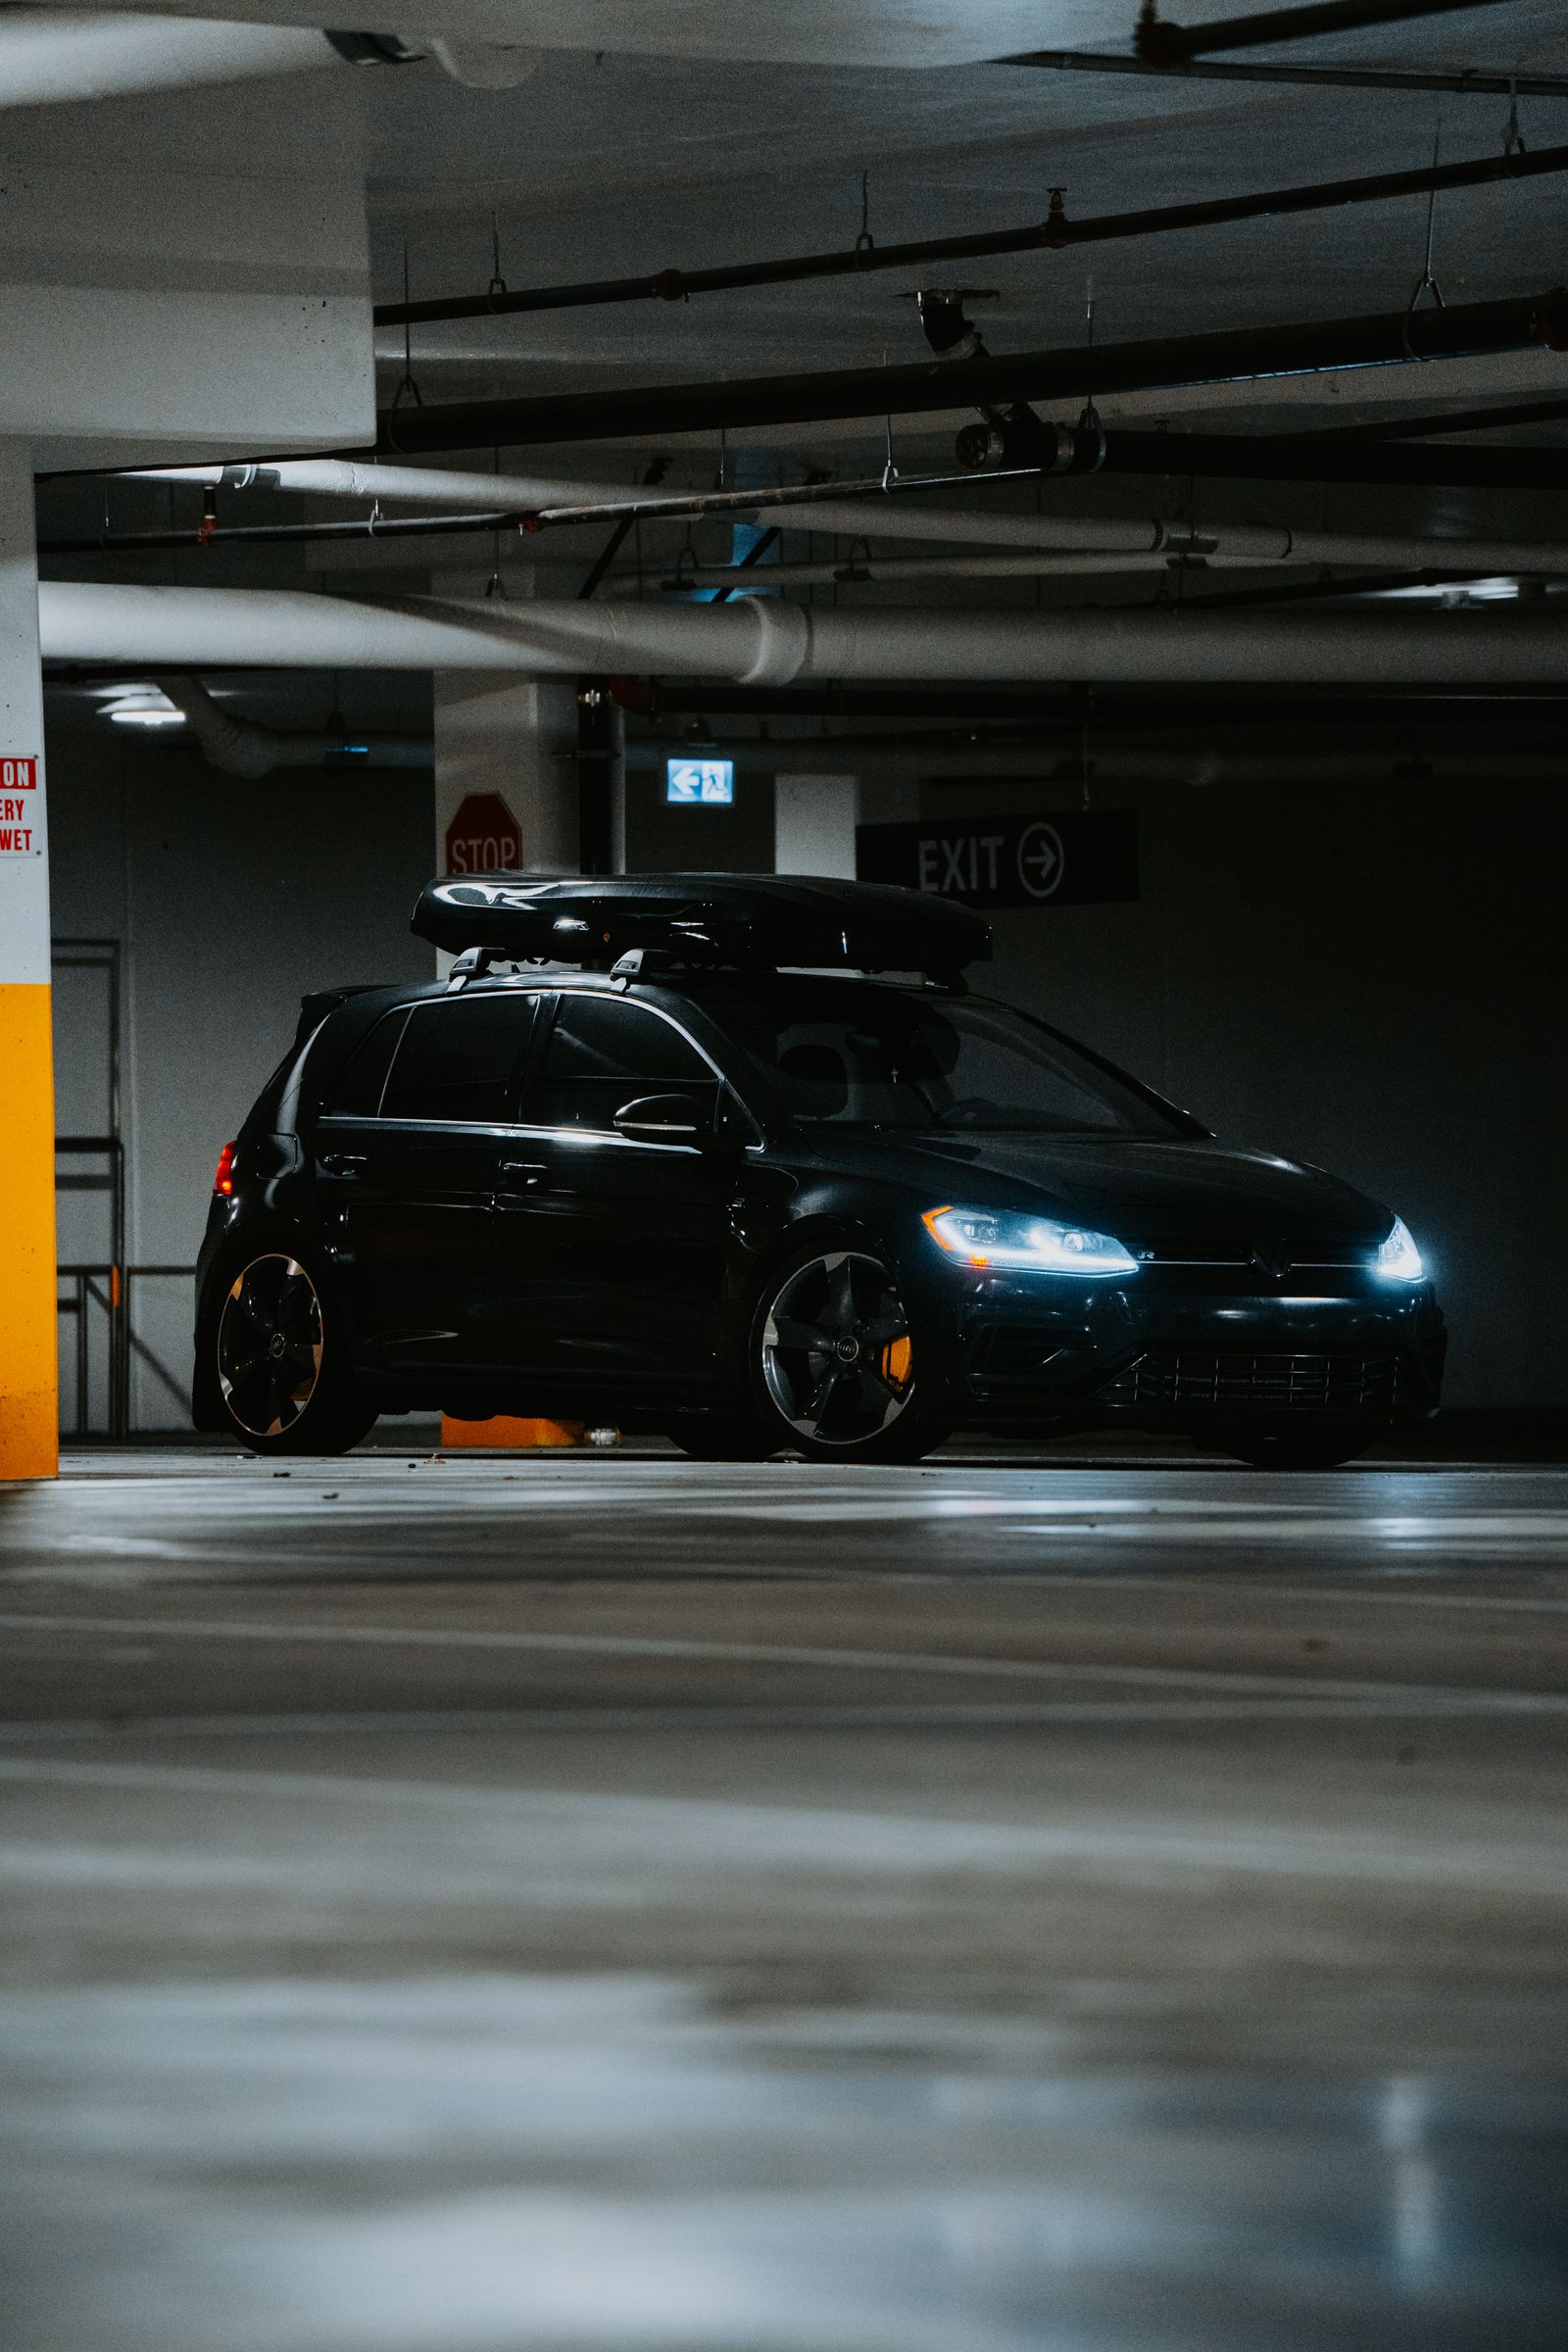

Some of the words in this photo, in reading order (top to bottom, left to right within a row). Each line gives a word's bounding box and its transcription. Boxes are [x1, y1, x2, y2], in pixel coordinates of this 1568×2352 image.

[0, 829, 32, 851] WET
[452, 836, 516, 874] STOP
[917, 835, 1004, 893] EXIT
